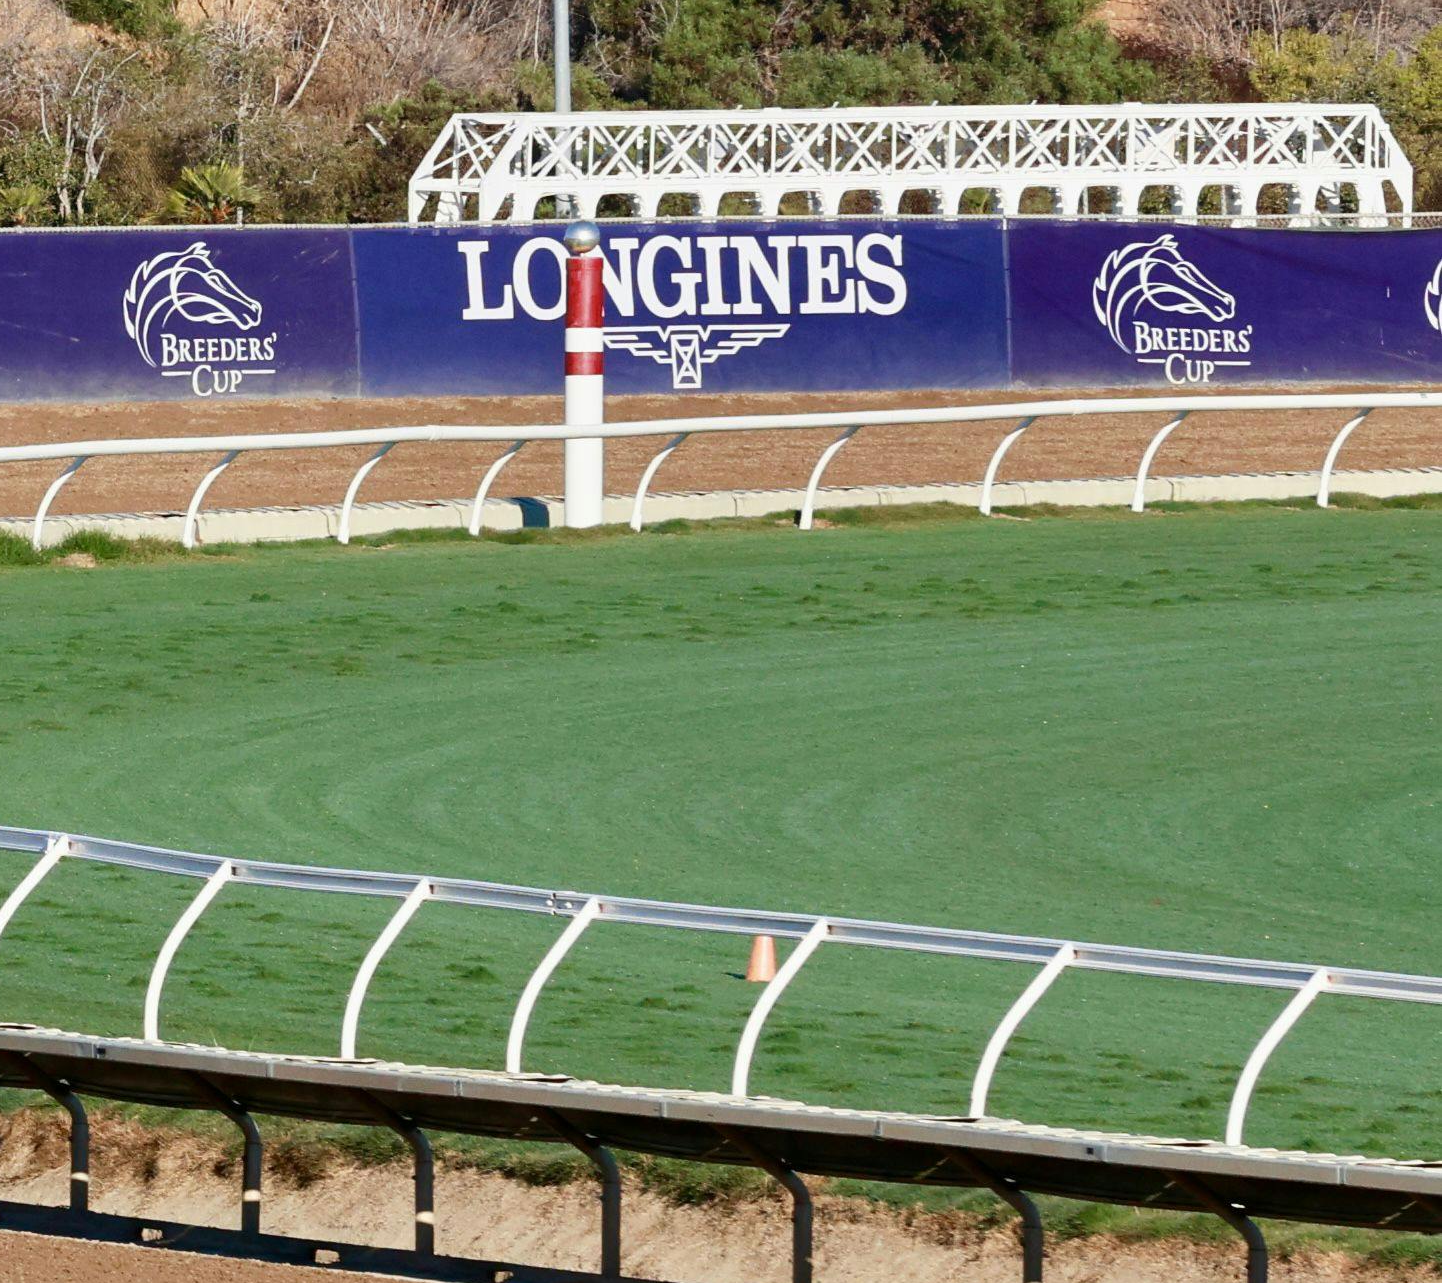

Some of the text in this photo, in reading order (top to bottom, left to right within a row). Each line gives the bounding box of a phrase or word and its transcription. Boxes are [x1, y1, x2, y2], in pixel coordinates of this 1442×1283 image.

[457, 232, 908, 321] LONGINES
[192, 364, 242, 396] CUP
[1165, 353, 1215, 385] CUP
